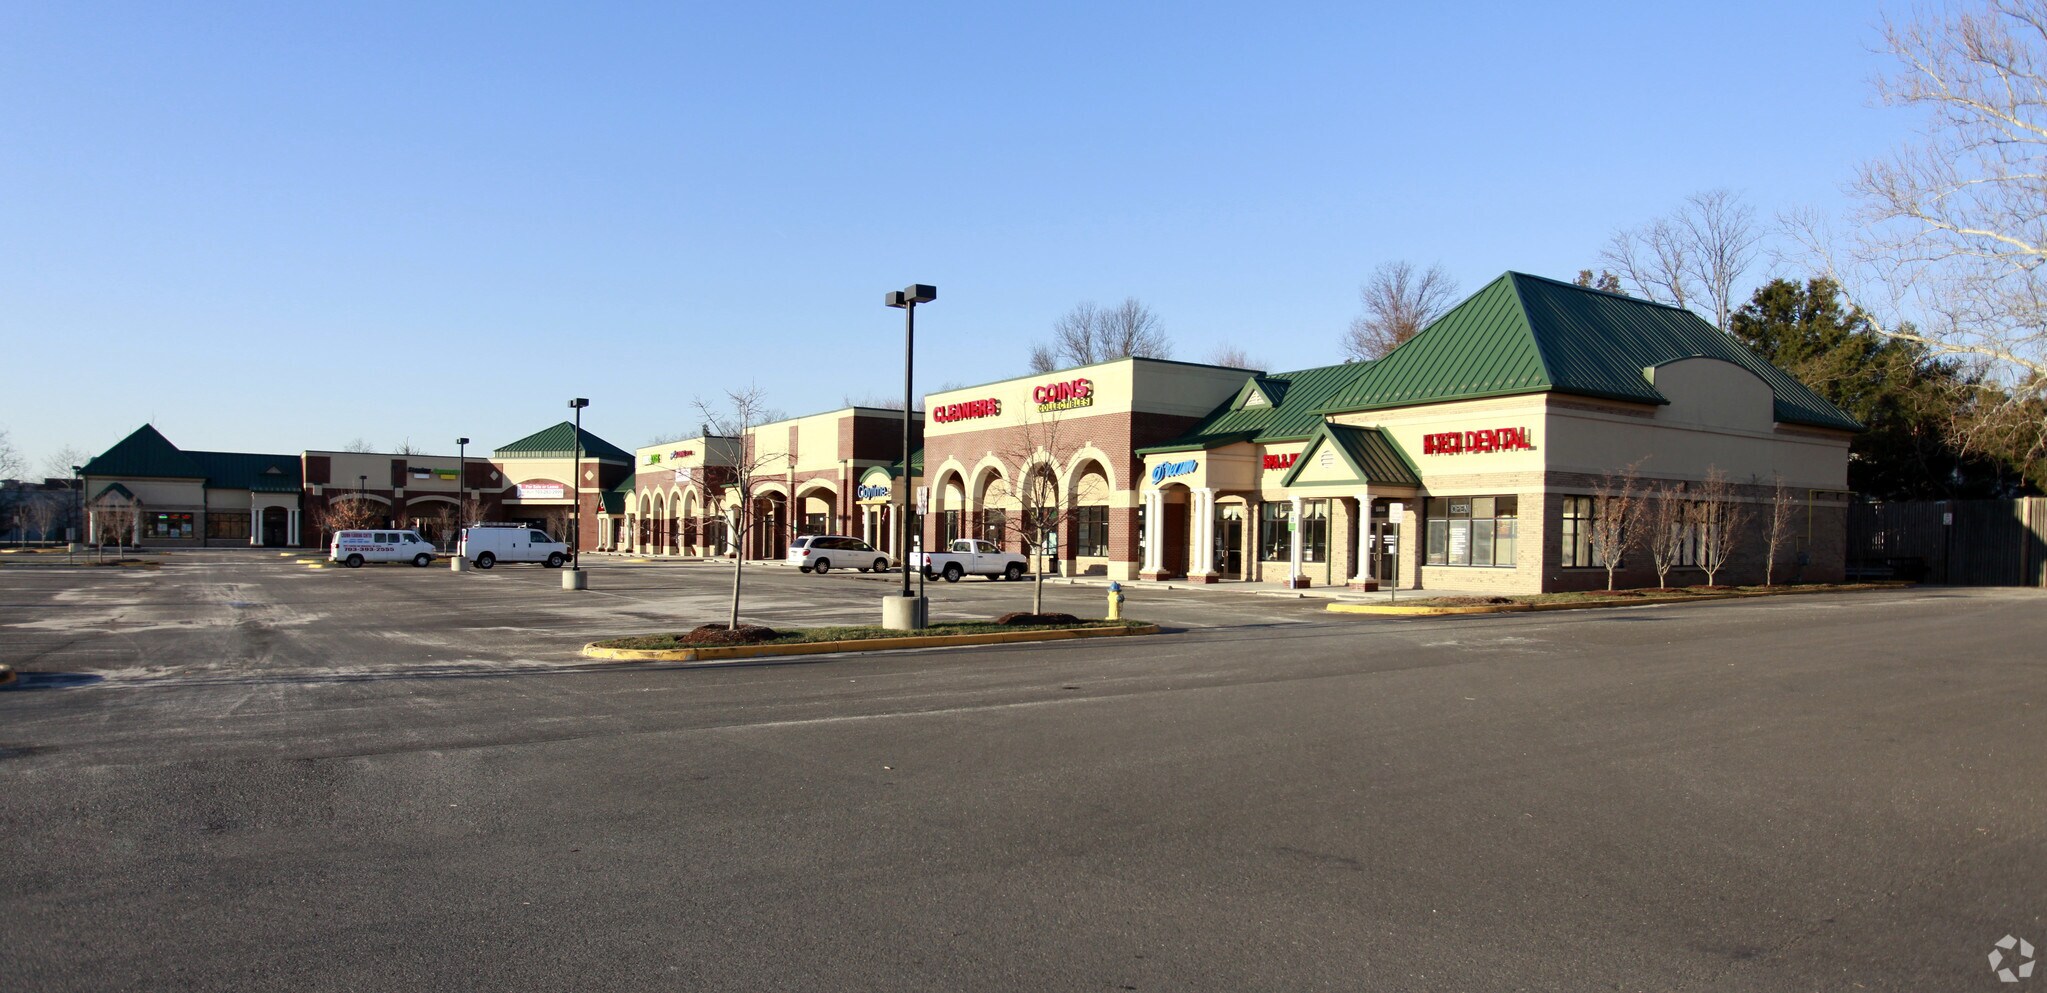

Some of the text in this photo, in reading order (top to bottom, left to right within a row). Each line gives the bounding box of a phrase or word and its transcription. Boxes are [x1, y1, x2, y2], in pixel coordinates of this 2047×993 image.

[1033, 378, 1090, 404] COINS
[933, 397, 998, 423] CLEANERS
[1037, 398, 1091, 413] COLLECTIBLES
[1464, 427, 1532, 452] DENTAL
[1450, 504, 1470, 514] OPEN
